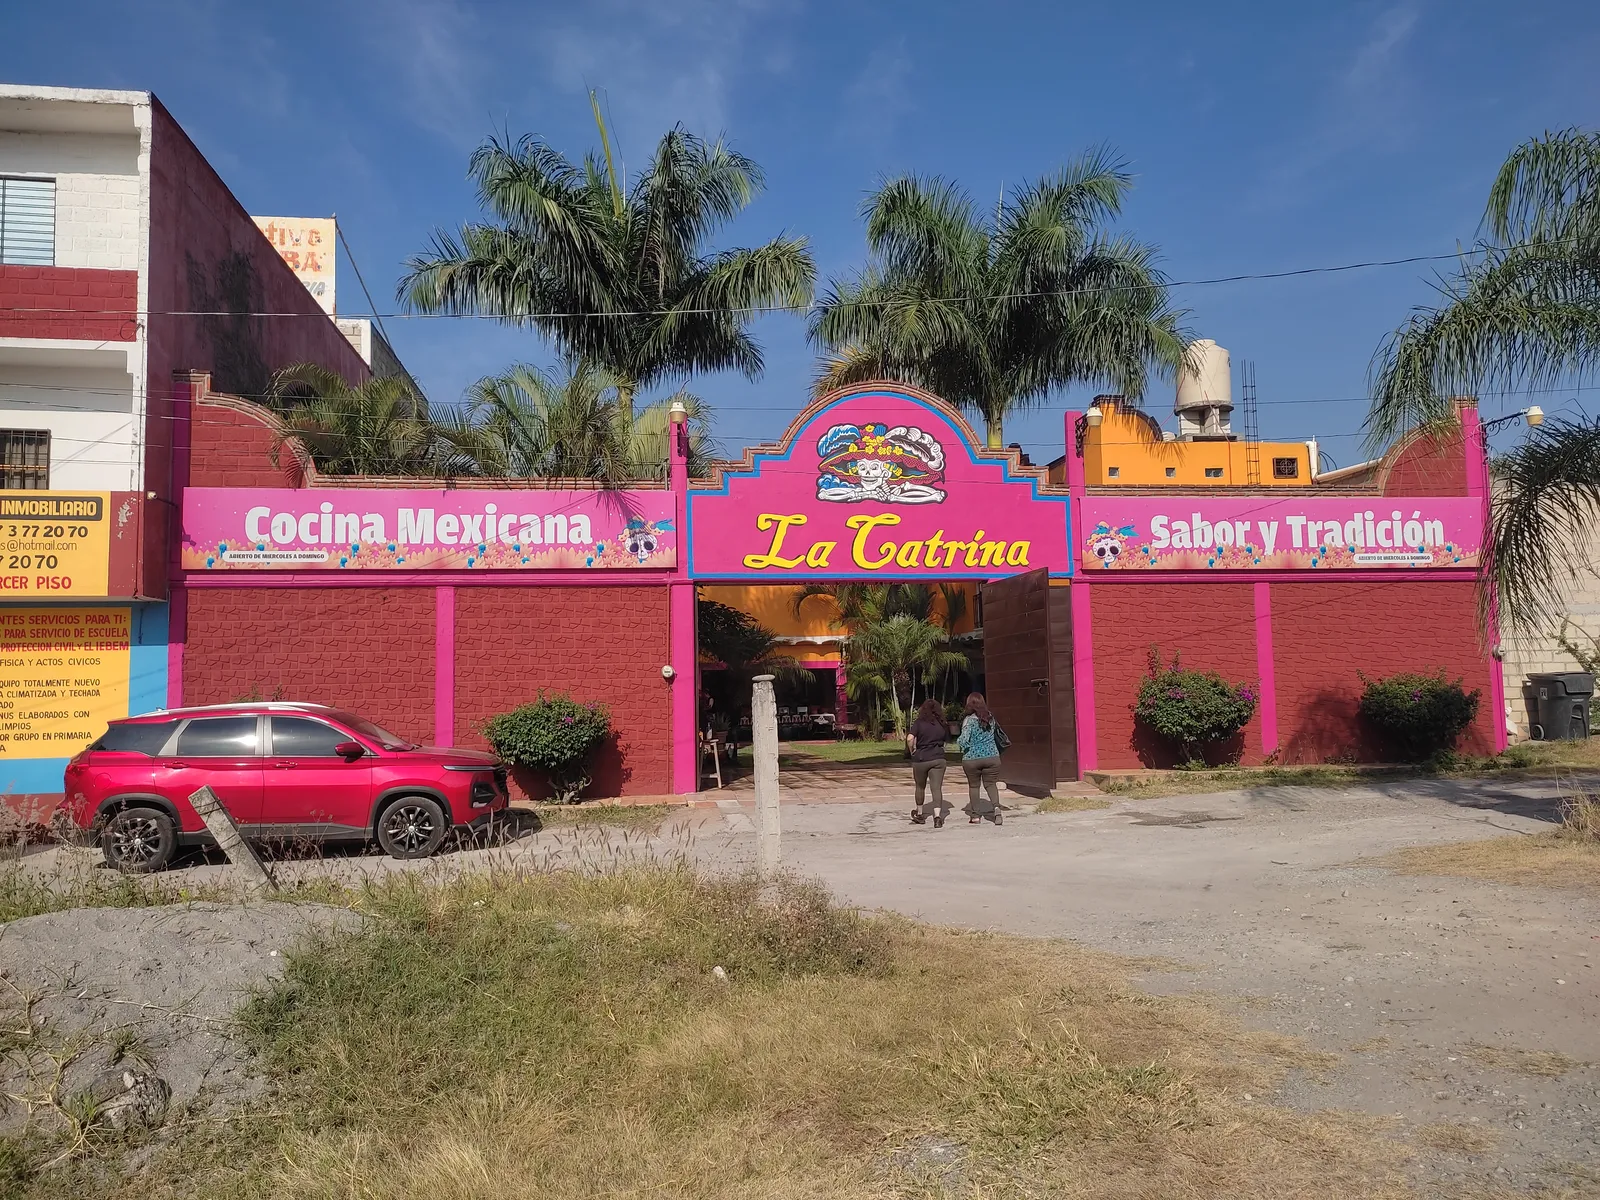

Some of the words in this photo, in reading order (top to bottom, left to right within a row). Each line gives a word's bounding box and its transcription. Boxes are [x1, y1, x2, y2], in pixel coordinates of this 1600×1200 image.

[0, 500, 97, 517] INMOBILIARIO
[244, 501, 386, 545] Cocina
[397, 503, 593, 546] Mexicana
[1150, 512, 1252, 549] Sabor
[1258, 521, 1279, 556] y
[1285, 510, 1445, 549] Tradición
[742, 513, 838, 570] La
[845, 513, 1031, 571] Catrina
[36, 575, 72, 590] PISO
[28, 614, 81, 625] SERVICIOS
[85, 614, 111, 624] PARA
[113, 614, 127, 624] TI:
[4, 628, 27, 639] PARA
[29, 628, 71, 638] SERVICIO
[73, 628, 85, 638] DE
[88, 627, 129, 638] ESCUELA
[0, 642, 52, 652] PROTECCION
[54, 641, 76, 651] CIVIL
[84, 641, 94, 651] EL
[96, 640, 129, 651] IEBEM
[27, 658, 34, 667] Y
[36, 658, 63, 666] ACTOS
[68, 657, 101, 666] CIVICOS
[23, 679, 70, 688] TOTALMENTE
[74, 678, 101, 687] NUEVO
[6, 690, 57, 699] CLIMATIZADA
[60, 689, 67, 698] Y
[69, 689, 101, 697] TECHADA
[18, 710, 69, 720] ELABORADOS
[73, 710, 90, 718] CON
[13, 732, 39, 741] GRUPO
[42, 732, 52, 740] EN
[53, 731, 93, 740] PRIMARIA
